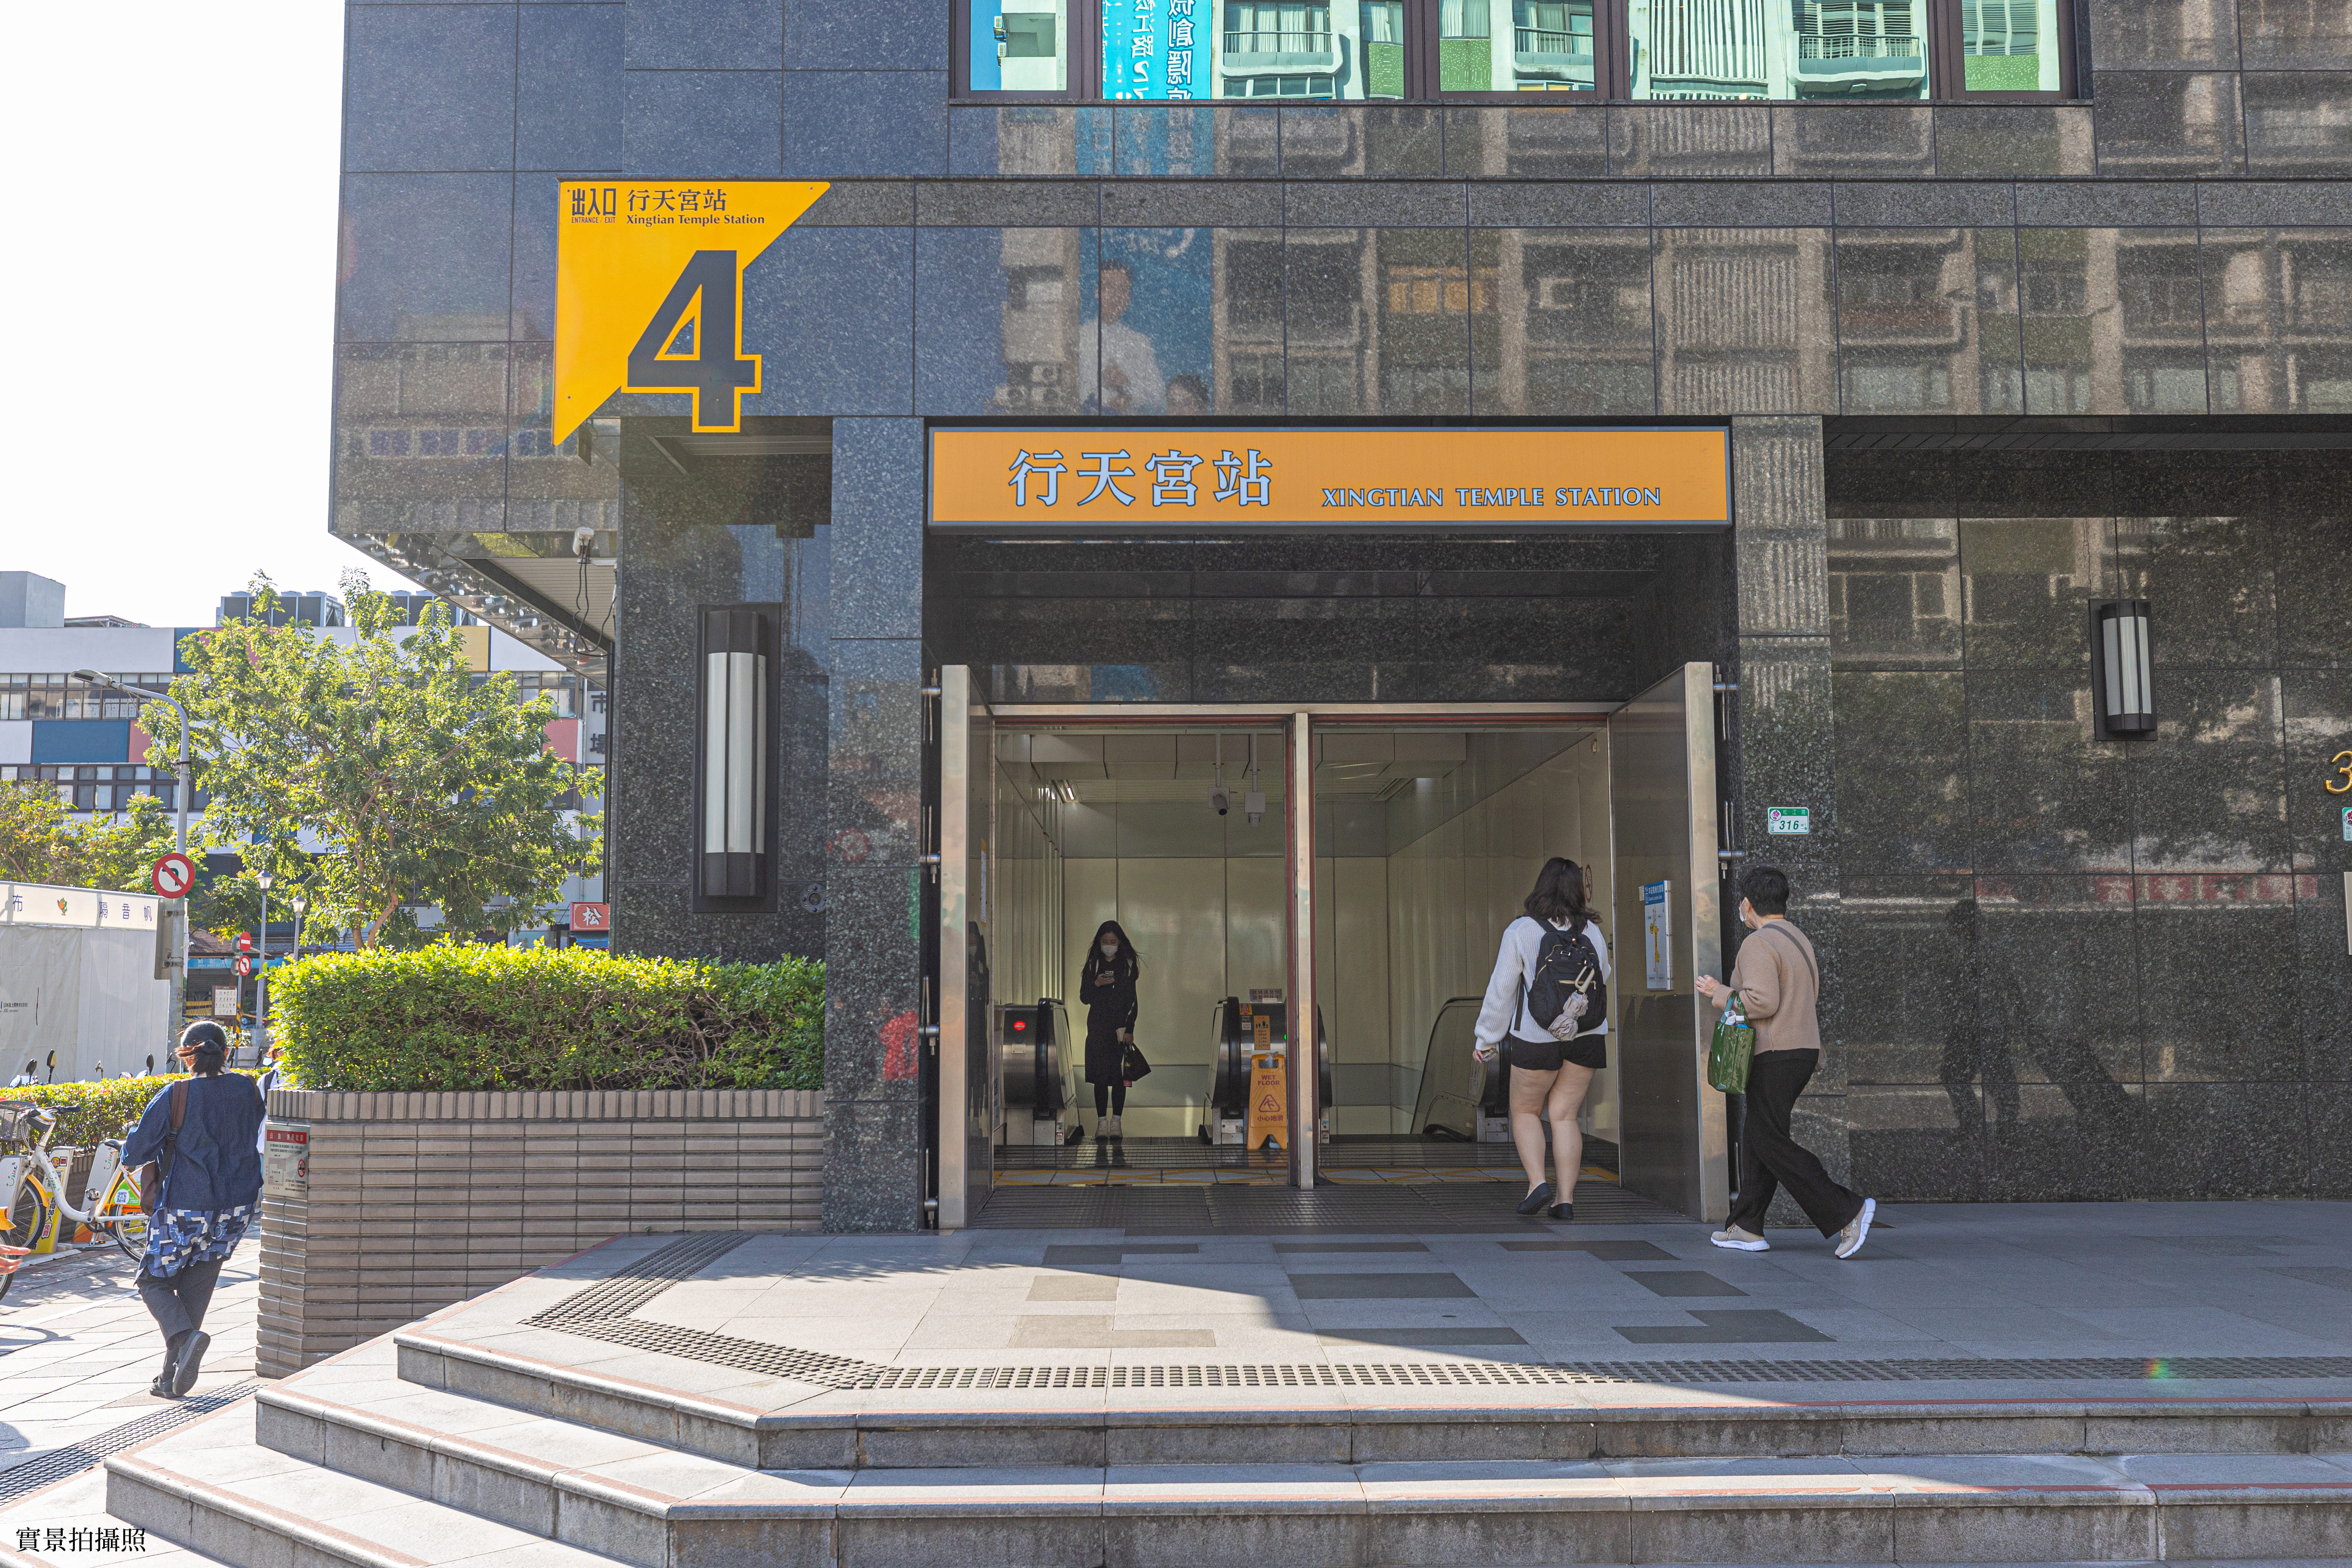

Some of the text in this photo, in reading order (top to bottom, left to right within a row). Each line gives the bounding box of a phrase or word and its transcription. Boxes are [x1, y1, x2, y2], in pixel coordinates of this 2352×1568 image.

[571, 188, 616, 216] 出入口
[627, 189, 727, 212] 行天宮站
[627, 214, 765, 227] Xingtian Temple Station
[628, 250, 755, 426] 4
[1009, 449, 1272, 507] 行天宮站
[1322, 487, 1660, 507] XINGTIAN TEMPLE STATION
[1779, 820, 1799, 830] 316
